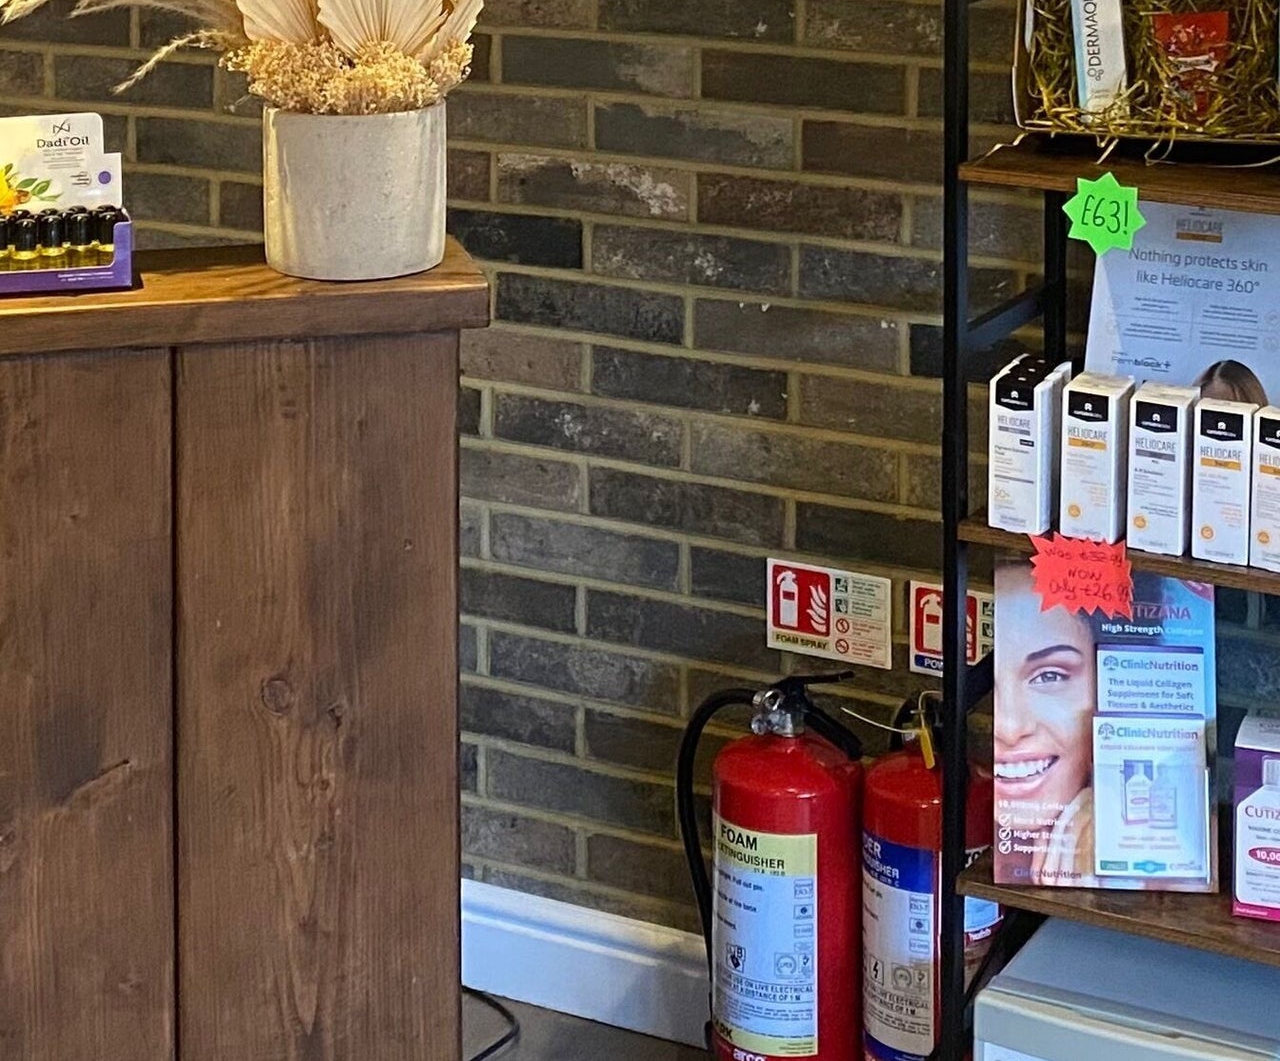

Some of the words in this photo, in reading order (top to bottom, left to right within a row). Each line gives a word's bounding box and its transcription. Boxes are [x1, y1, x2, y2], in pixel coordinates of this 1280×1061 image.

[37, 137, 67, 149] Dadi
[69, 136, 90, 146] Oil
[1129, 248, 1181, 266] Nothing
[1184, 253, 1238, 270] protects
[1240, 258, 1268, 272] skin
[1136, 270, 1158, 285] like
[1161, 272, 1223, 290] Heliocare
[997, 414, 1031, 429] HELIOCARE
[1067, 425, 1108, 441] HELIOCARE
[1135, 437, 1176, 453] HELIOCARE
[1199, 445, 1242, 461] HELIOCARE
[1133, 604, 1191, 620] TIZANA
[1101, 624, 1122, 634] High
[1124, 625, 1164, 636] Strength
[776, 634, 799, 646] FOAM
[800, 638, 829, 651] SPRAY
[924, 657, 944, 671] POW
[1120, 659, 1199, 671] ClinicNutrition
[1161, 690, 1174, 699] for
[1116, 727, 1198, 739] ClinicNutrition
[720, 824, 758, 851] FOAM
[770, 986, 813, 994] ELECTRICAL
